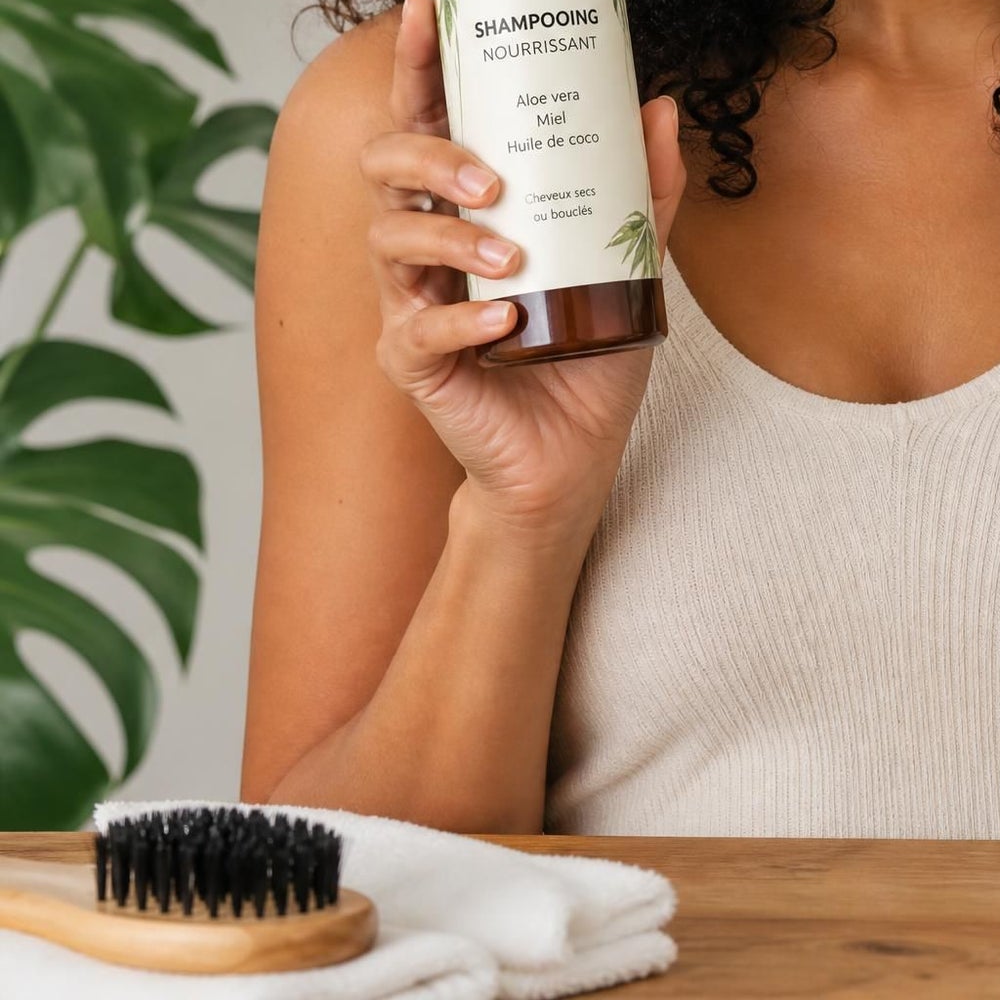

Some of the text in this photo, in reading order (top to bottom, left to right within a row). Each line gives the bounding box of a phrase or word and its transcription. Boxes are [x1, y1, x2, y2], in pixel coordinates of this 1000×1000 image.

[475, 9, 598, 38] SHAMPOOING
[483, 36, 597, 62] NOURRISSANT
[516, 91, 579, 108] Aloe vera
[537, 111, 566, 127] Miel
[508, 134, 599, 154] Huile de coco
[525, 188, 596, 204] Cheveux secs
[534, 205, 592, 222] ou bouclés
